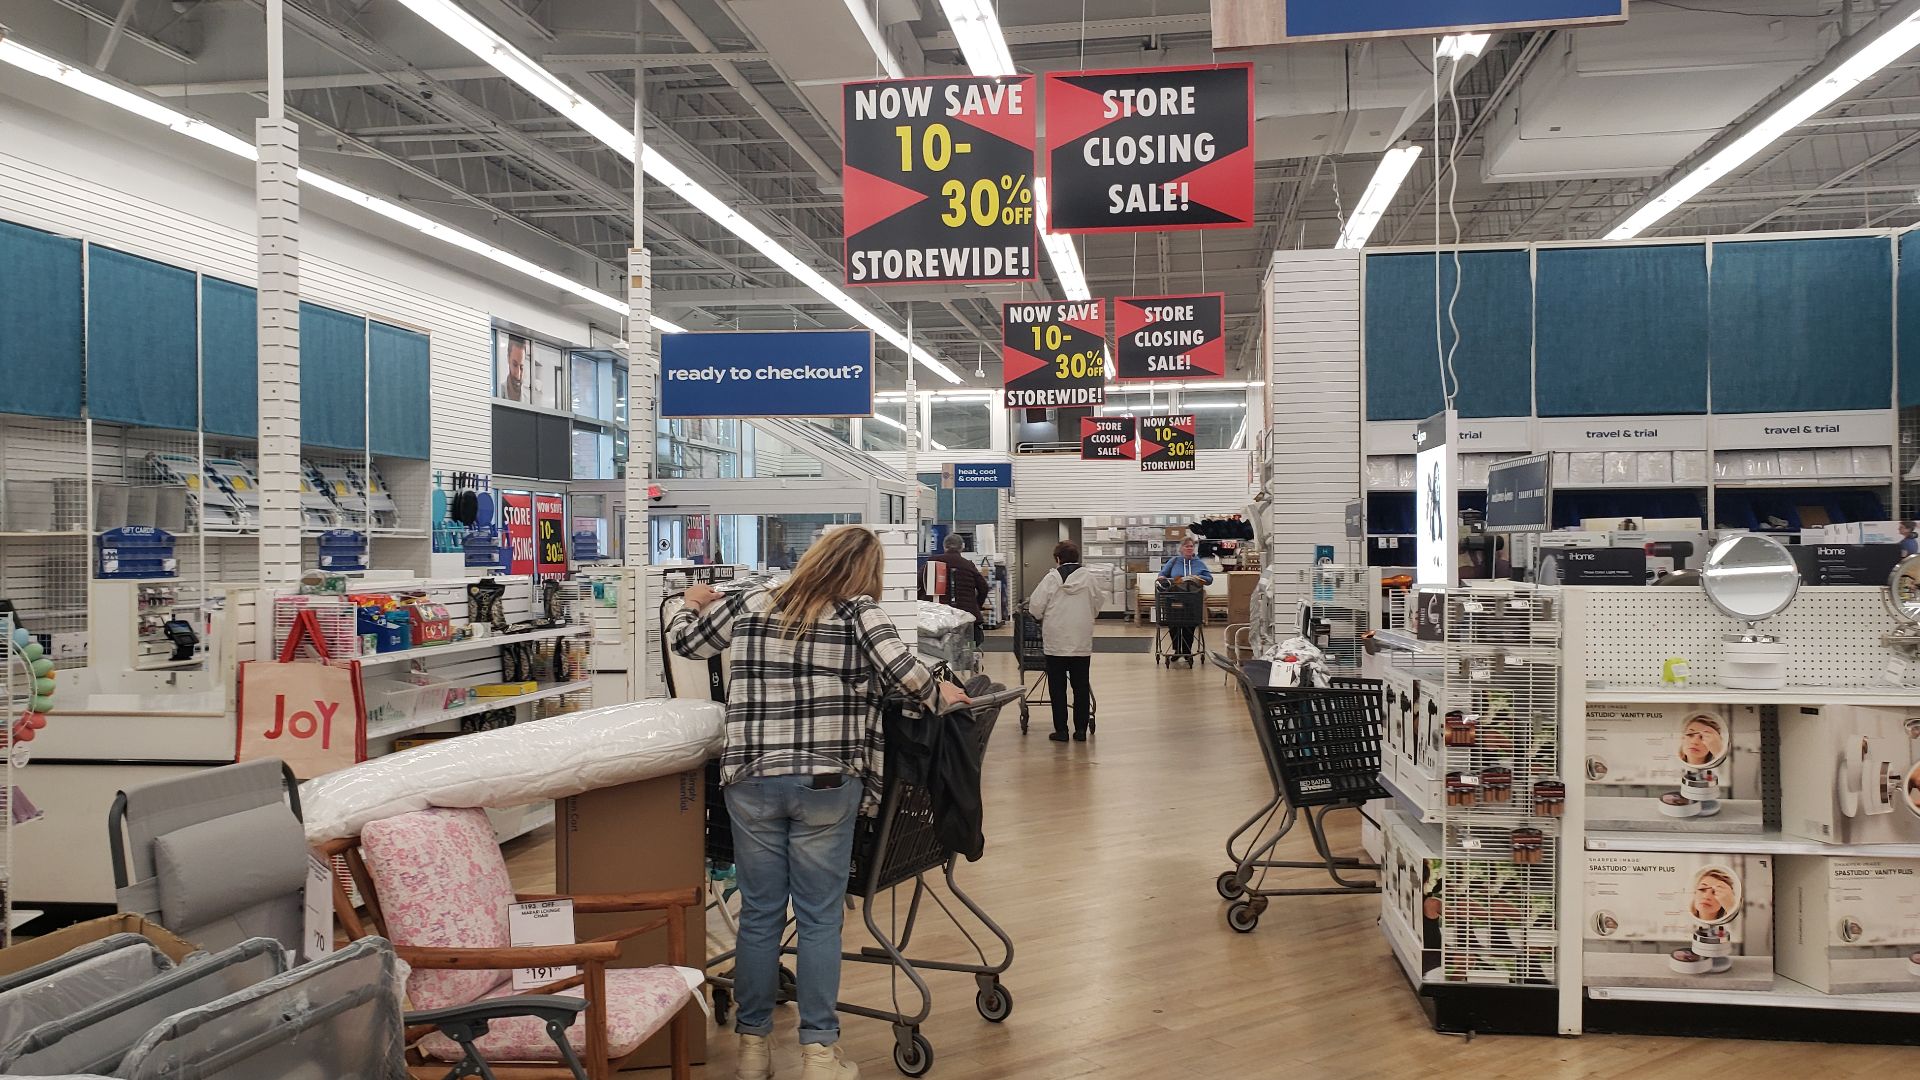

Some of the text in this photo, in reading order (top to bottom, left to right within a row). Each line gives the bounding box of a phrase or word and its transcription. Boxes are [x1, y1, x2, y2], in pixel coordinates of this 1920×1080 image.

[855, 84, 1024, 120] NOW SAVE
[1102, 86, 1196, 119] STORE
[896, 123, 971, 172] 10-
[1083, 132, 1216, 167] CLOSING
[1108, 182, 1190, 214] SALE!
[1001, 207, 1033, 225] OFF
[851, 246, 1031, 281] STOREWIDE!
[1009, 303, 1099, 323] NOW SAVE
[1144, 305, 1194, 322] STORE
[1031, 325, 1072, 351] 10-
[1134, 330, 1205, 347] CLOSING
[1148, 355, 1191, 371] SALE!
[668, 364, 864, 384] ready to checkout?
[1086, 366, 1104, 377] OFF
[1007, 387, 1102, 406] STOREWIDE!
[1096, 422, 1122, 431] STORE
[1143, 416, 1192, 427] NOW SAVE
[1764, 424, 1840, 435] travel & trial
[1091, 434, 1127, 443] CLOSING
[1155, 428, 1178, 441] 10-
[1459, 430, 1482, 440] trial
[1586, 428, 1658, 439] travel & trial
[1097, 447, 1120, 456] SALE!
[958, 468, 979, 476] heat,
[1142, 460, 1194, 470] STOREWIDE!
[504, 506, 531, 525] STORE
[537, 502, 563, 514] NOW SAVE
[540, 520, 554, 540] 10-
[1569, 552, 1595, 560] iHome
[1817, 546, 1846, 555] iHome
